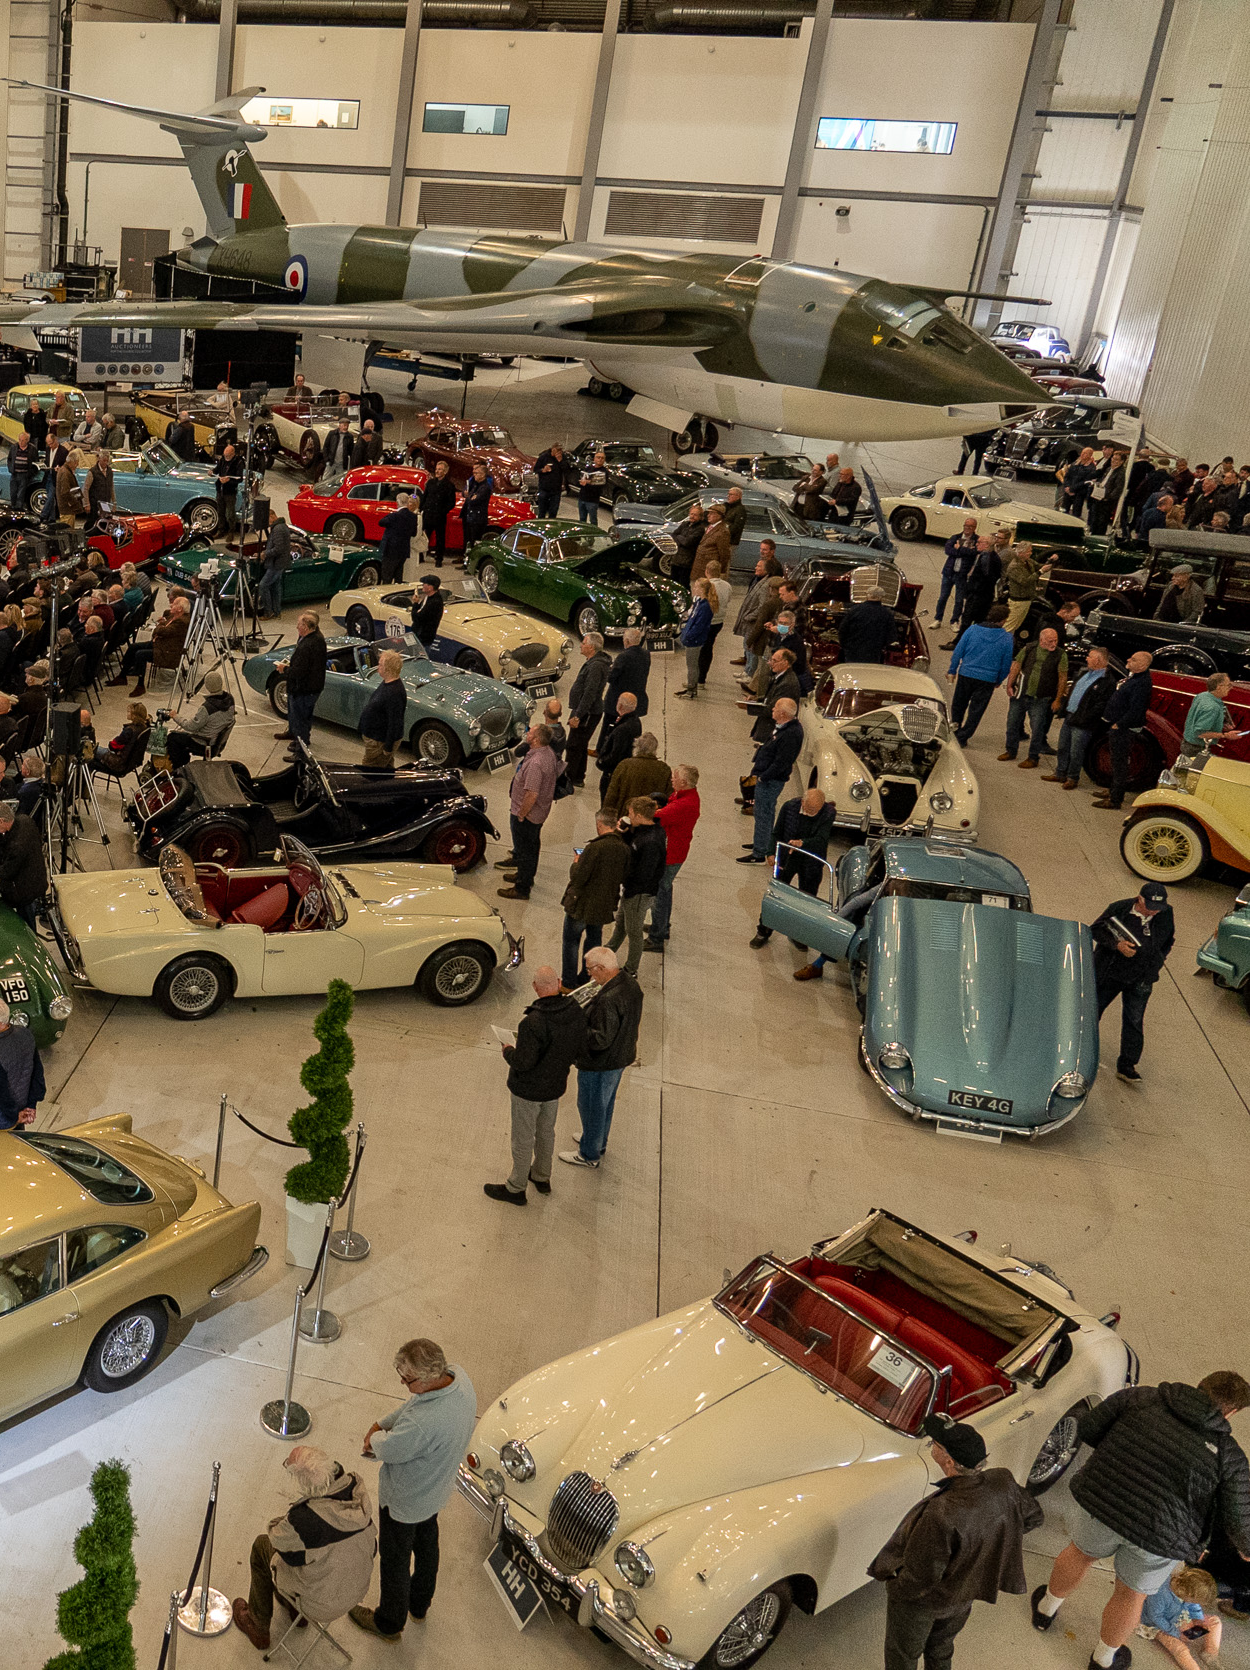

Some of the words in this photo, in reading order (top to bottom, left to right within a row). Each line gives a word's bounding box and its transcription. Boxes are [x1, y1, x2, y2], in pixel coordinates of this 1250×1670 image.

[174, 570, 184, 579] DUB
[390, 624, 401, 637] 176
[653, 641, 667, 650] HH
[535, 687, 548, 697] HH
[493, 753, 505, 764] HH
[879, 828, 904, 837] 4517
[0, 979, 25, 990] VFO
[6, 990, 28, 1003] 150
[951, 1092, 984, 1108] KEY
[987, 1099, 1010, 1113] 4G
[885, 1352, 903, 1367] 36
[501, 1560, 526, 1600] HH
[512, 1544, 538, 1580] YCD
[541, 1575, 571, 1612] 354
